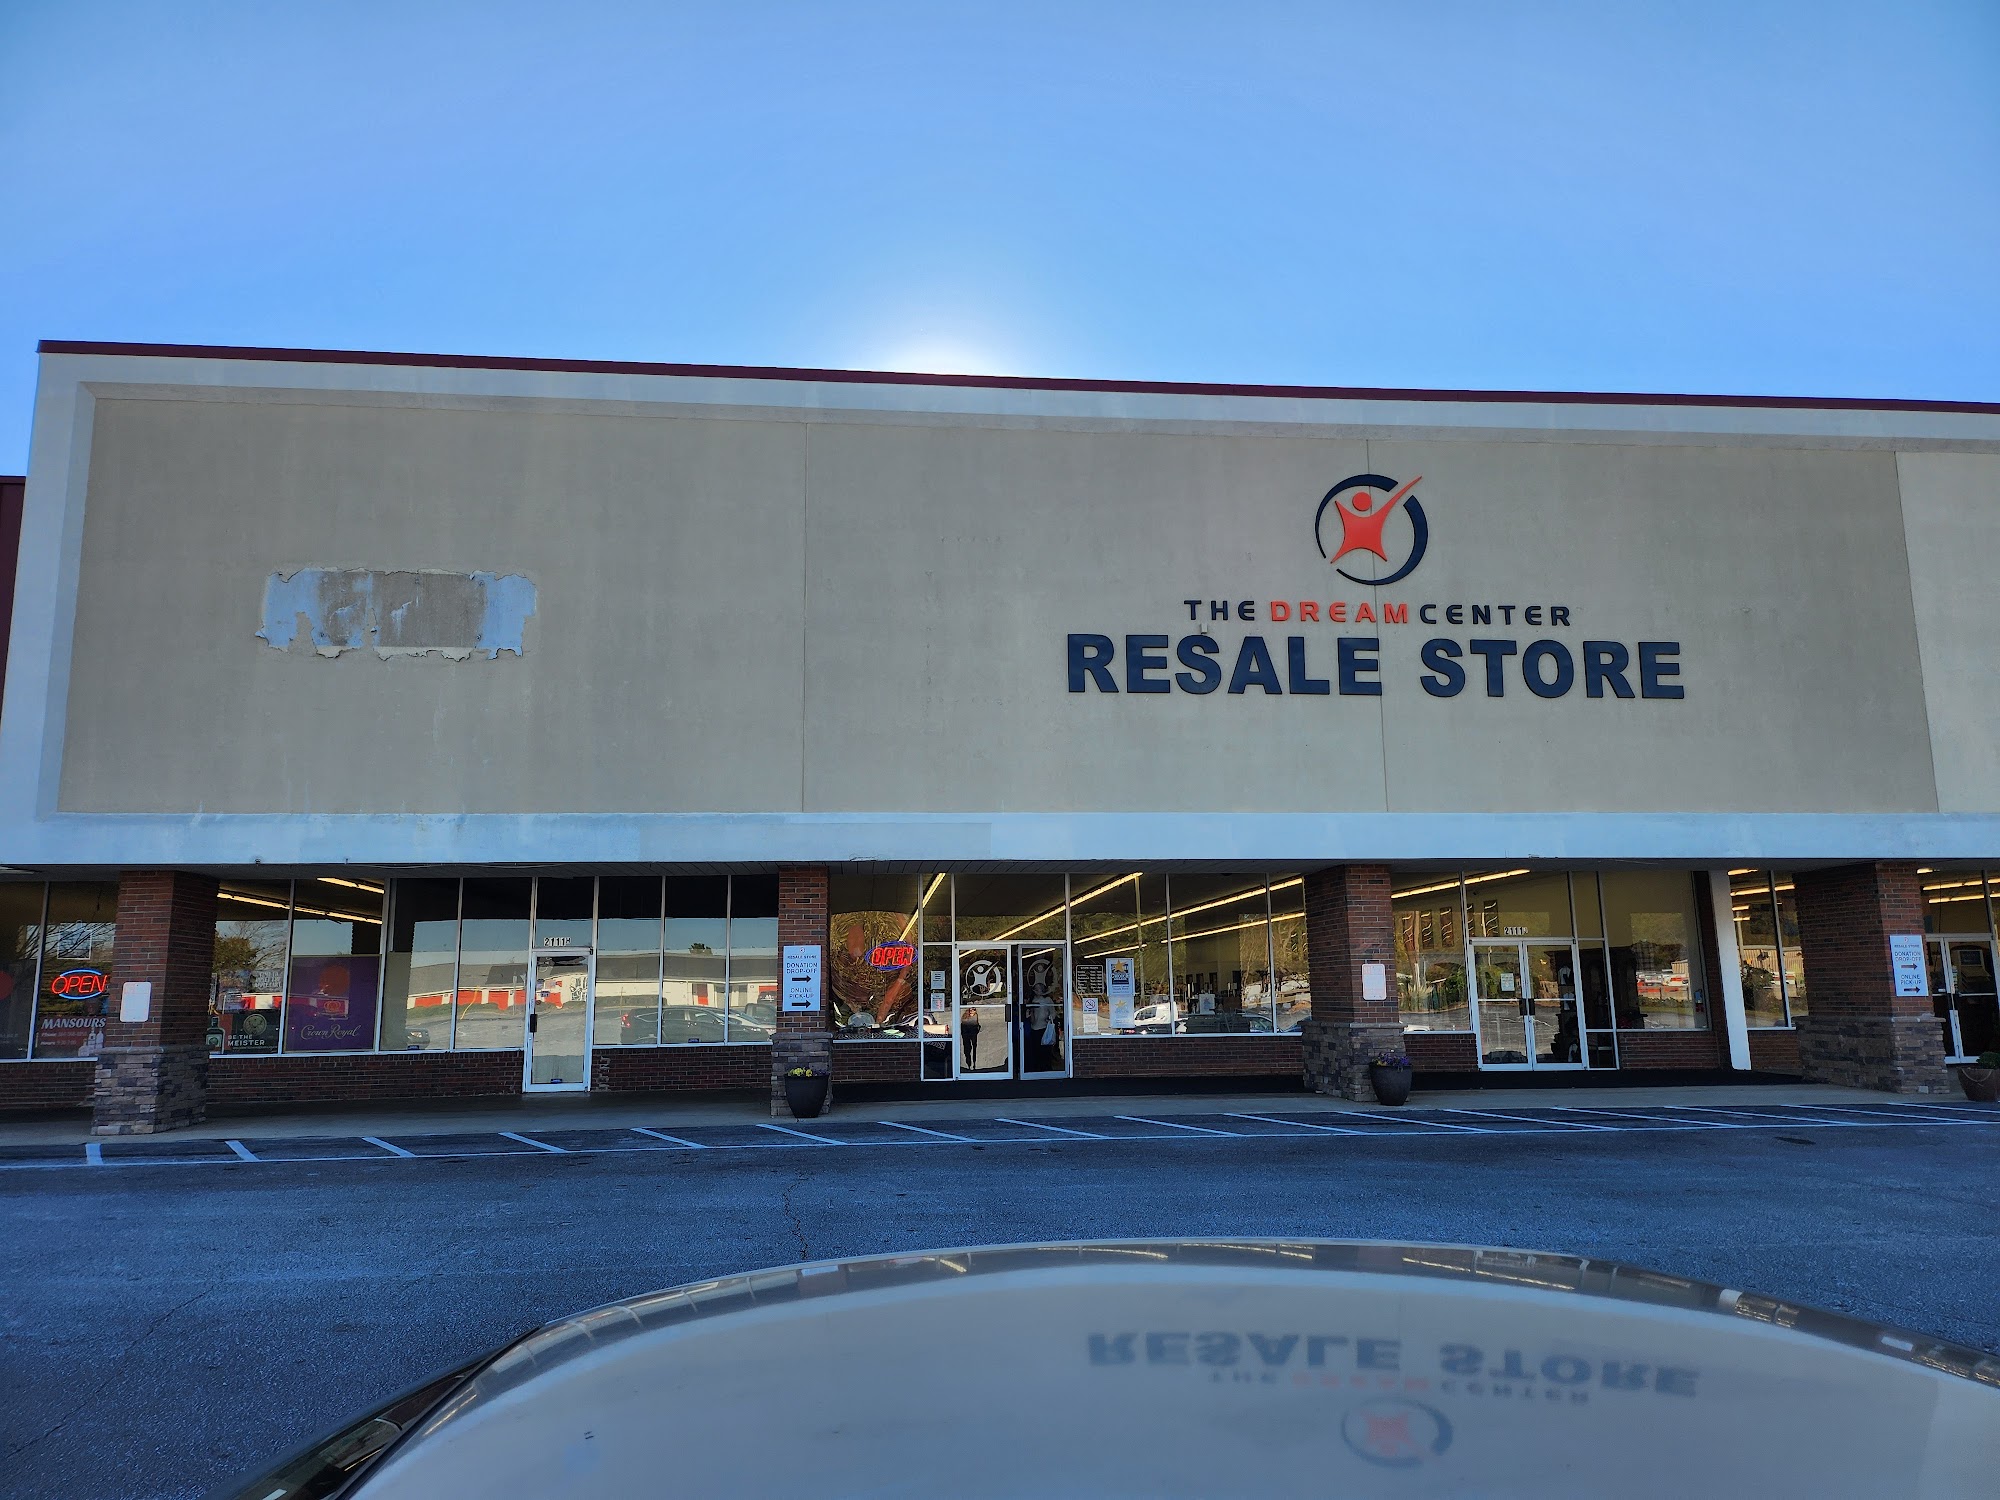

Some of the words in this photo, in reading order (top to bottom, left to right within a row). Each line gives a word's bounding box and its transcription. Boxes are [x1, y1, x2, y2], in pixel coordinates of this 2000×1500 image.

[1183, 600, 1255, 621] THE
[1270, 601, 1408, 624] DREAM
[1419, 603, 1571, 626] CENTER
[1067, 633, 1383, 696] RESALE
[1420, 638, 1685, 699] STORE
[871, 946, 914, 966] OPEN
[51, 975, 107, 994] OPEN
[41, 1018, 106, 1029] MANSOURS
[300, 1024, 328, 1040] Crown
[328, 1024, 362, 1040] Royal
[227, 1039, 265, 1047] MEISTER
